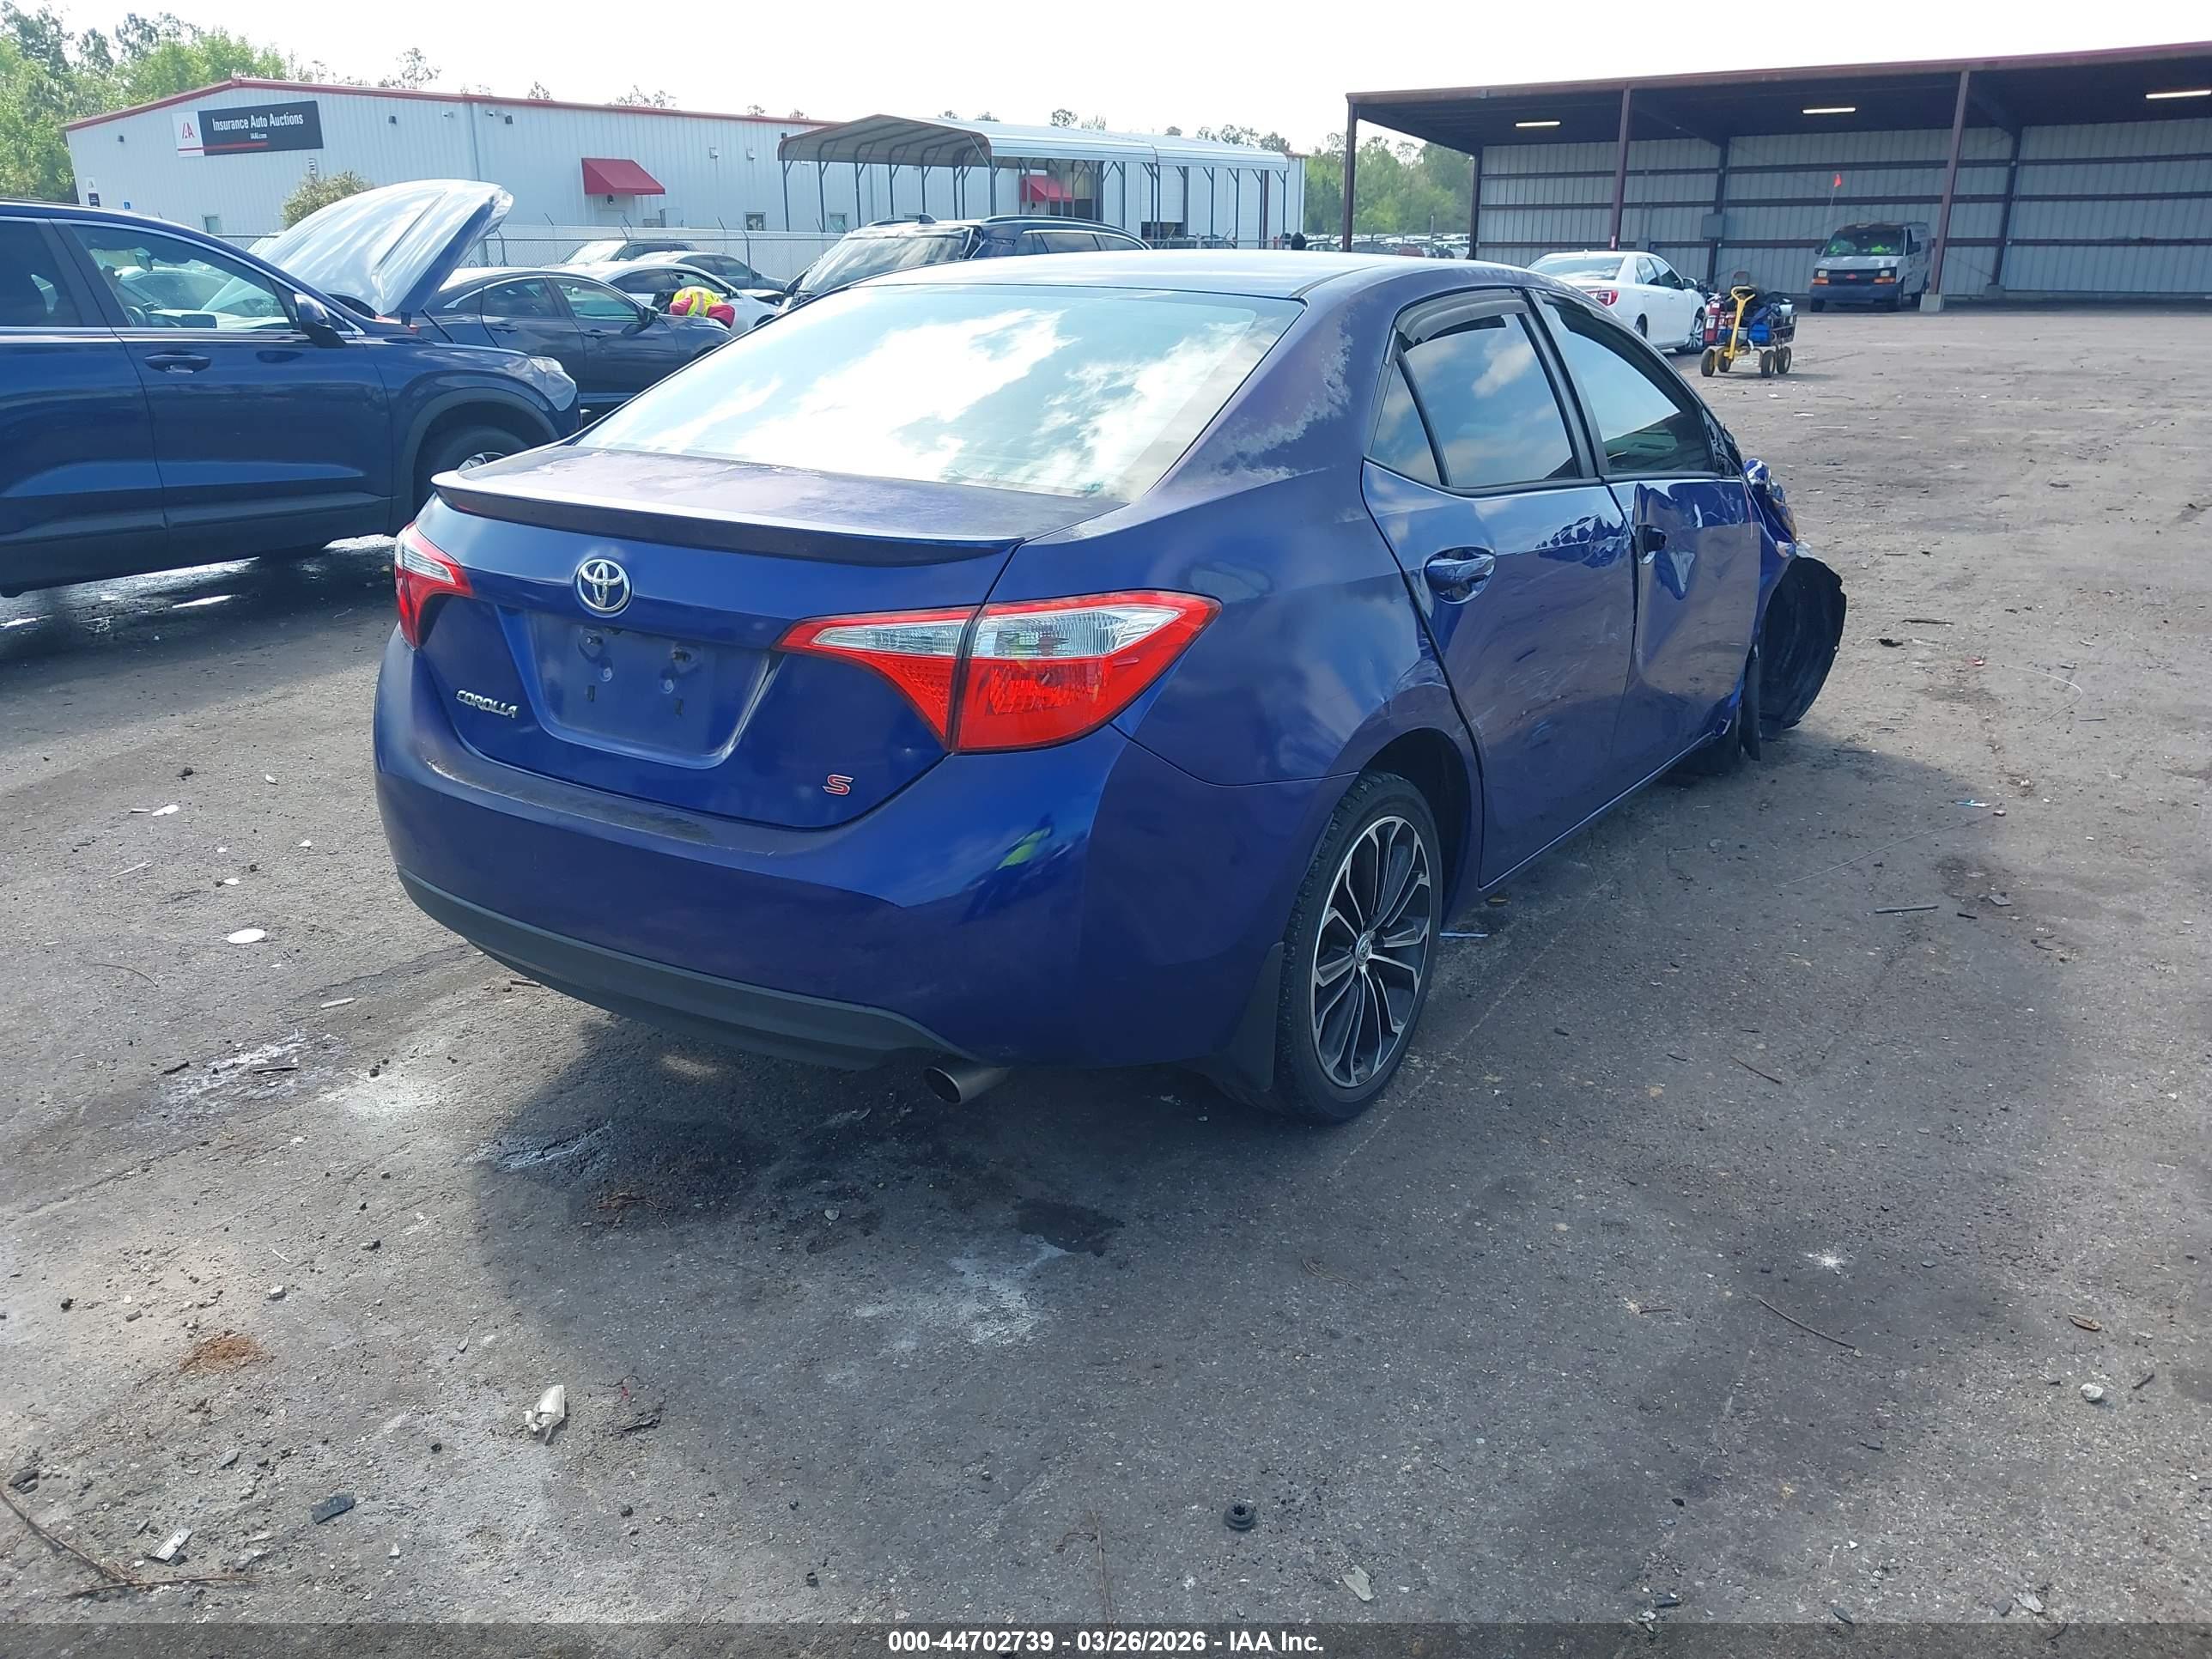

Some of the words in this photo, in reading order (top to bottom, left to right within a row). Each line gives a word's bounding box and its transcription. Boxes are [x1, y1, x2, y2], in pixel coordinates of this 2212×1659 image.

[212, 118, 249, 131] Insurance
[250, 114, 268, 128] Auto
[269, 112, 304, 126] Auctions
[455, 690, 519, 719] COROLLA
[822, 774, 854, 795] S
